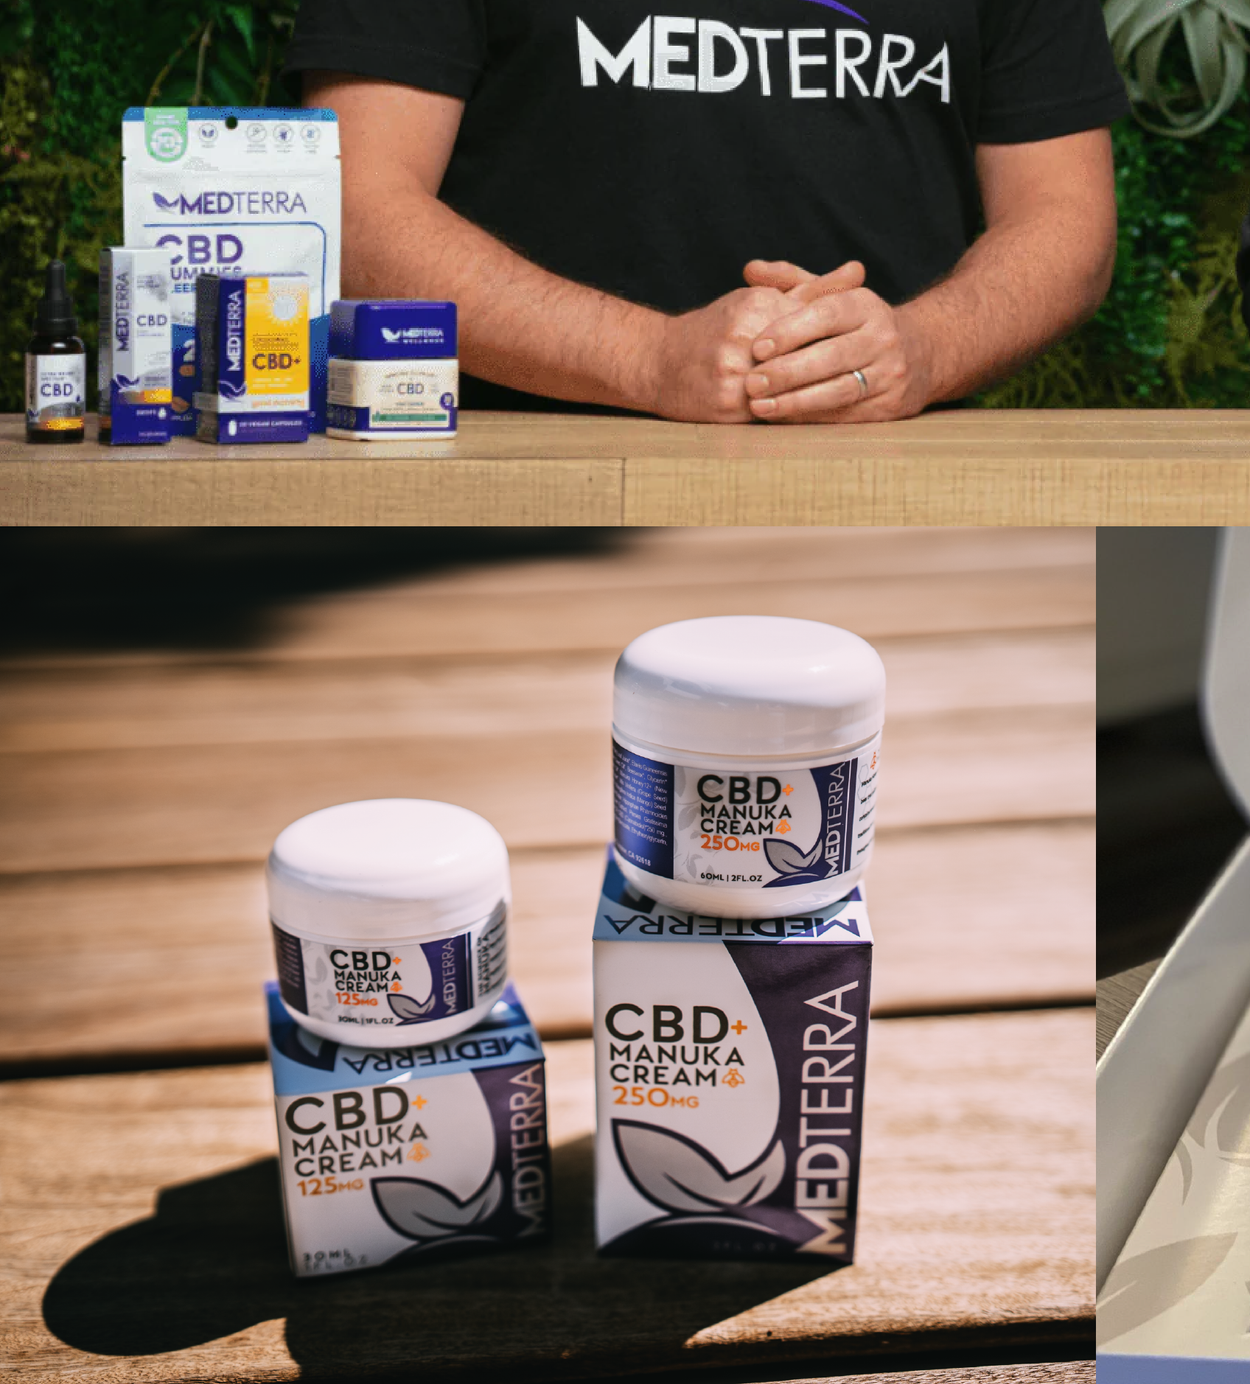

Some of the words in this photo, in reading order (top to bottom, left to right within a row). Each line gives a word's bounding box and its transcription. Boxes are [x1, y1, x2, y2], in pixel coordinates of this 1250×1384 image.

[576, 15, 950, 103] MEDTERRA
[180, 191, 307, 216] MEDTERRA
[116, 271, 129, 352] MEDTERRA
[137, 315, 167, 327] CBD
[226, 290, 241, 372] MEDTERRA
[252, 353, 301, 371] CBD+
[41, 383, 73, 397] CBD
[397, 383, 424, 395] CBD
[701, 804, 792, 820] MANUKA
[824, 762, 846, 879] MEDTERRA
[701, 819, 774, 835] CREAM
[700, 834, 760, 852] 250MG
[700, 872, 725, 882] 60ML
[603, 914, 860, 937] MEDTERRA
[333, 969, 402, 982] MANUKA
[335, 980, 388, 993] CREAM
[441, 938, 455, 1017] MEDTERRA
[335, 992, 379, 1007] 125MG
[605, 1003, 748, 1044] CBD+
[342, 1032, 538, 1075] MEDTERRA
[610, 1043, 744, 1066] MANUKA
[610, 1064, 716, 1087] CREAM
[612, 1086, 699, 1109] 250MG
[285, 1086, 428, 1136] CBD+
[795, 980, 859, 1254] MEDTERRA
[292, 1122, 428, 1157] MANUKA
[508, 1063, 546, 1239] MEDTERRA
[294, 1147, 403, 1177] CREAM
[297, 1176, 364, 1197] 125MG
